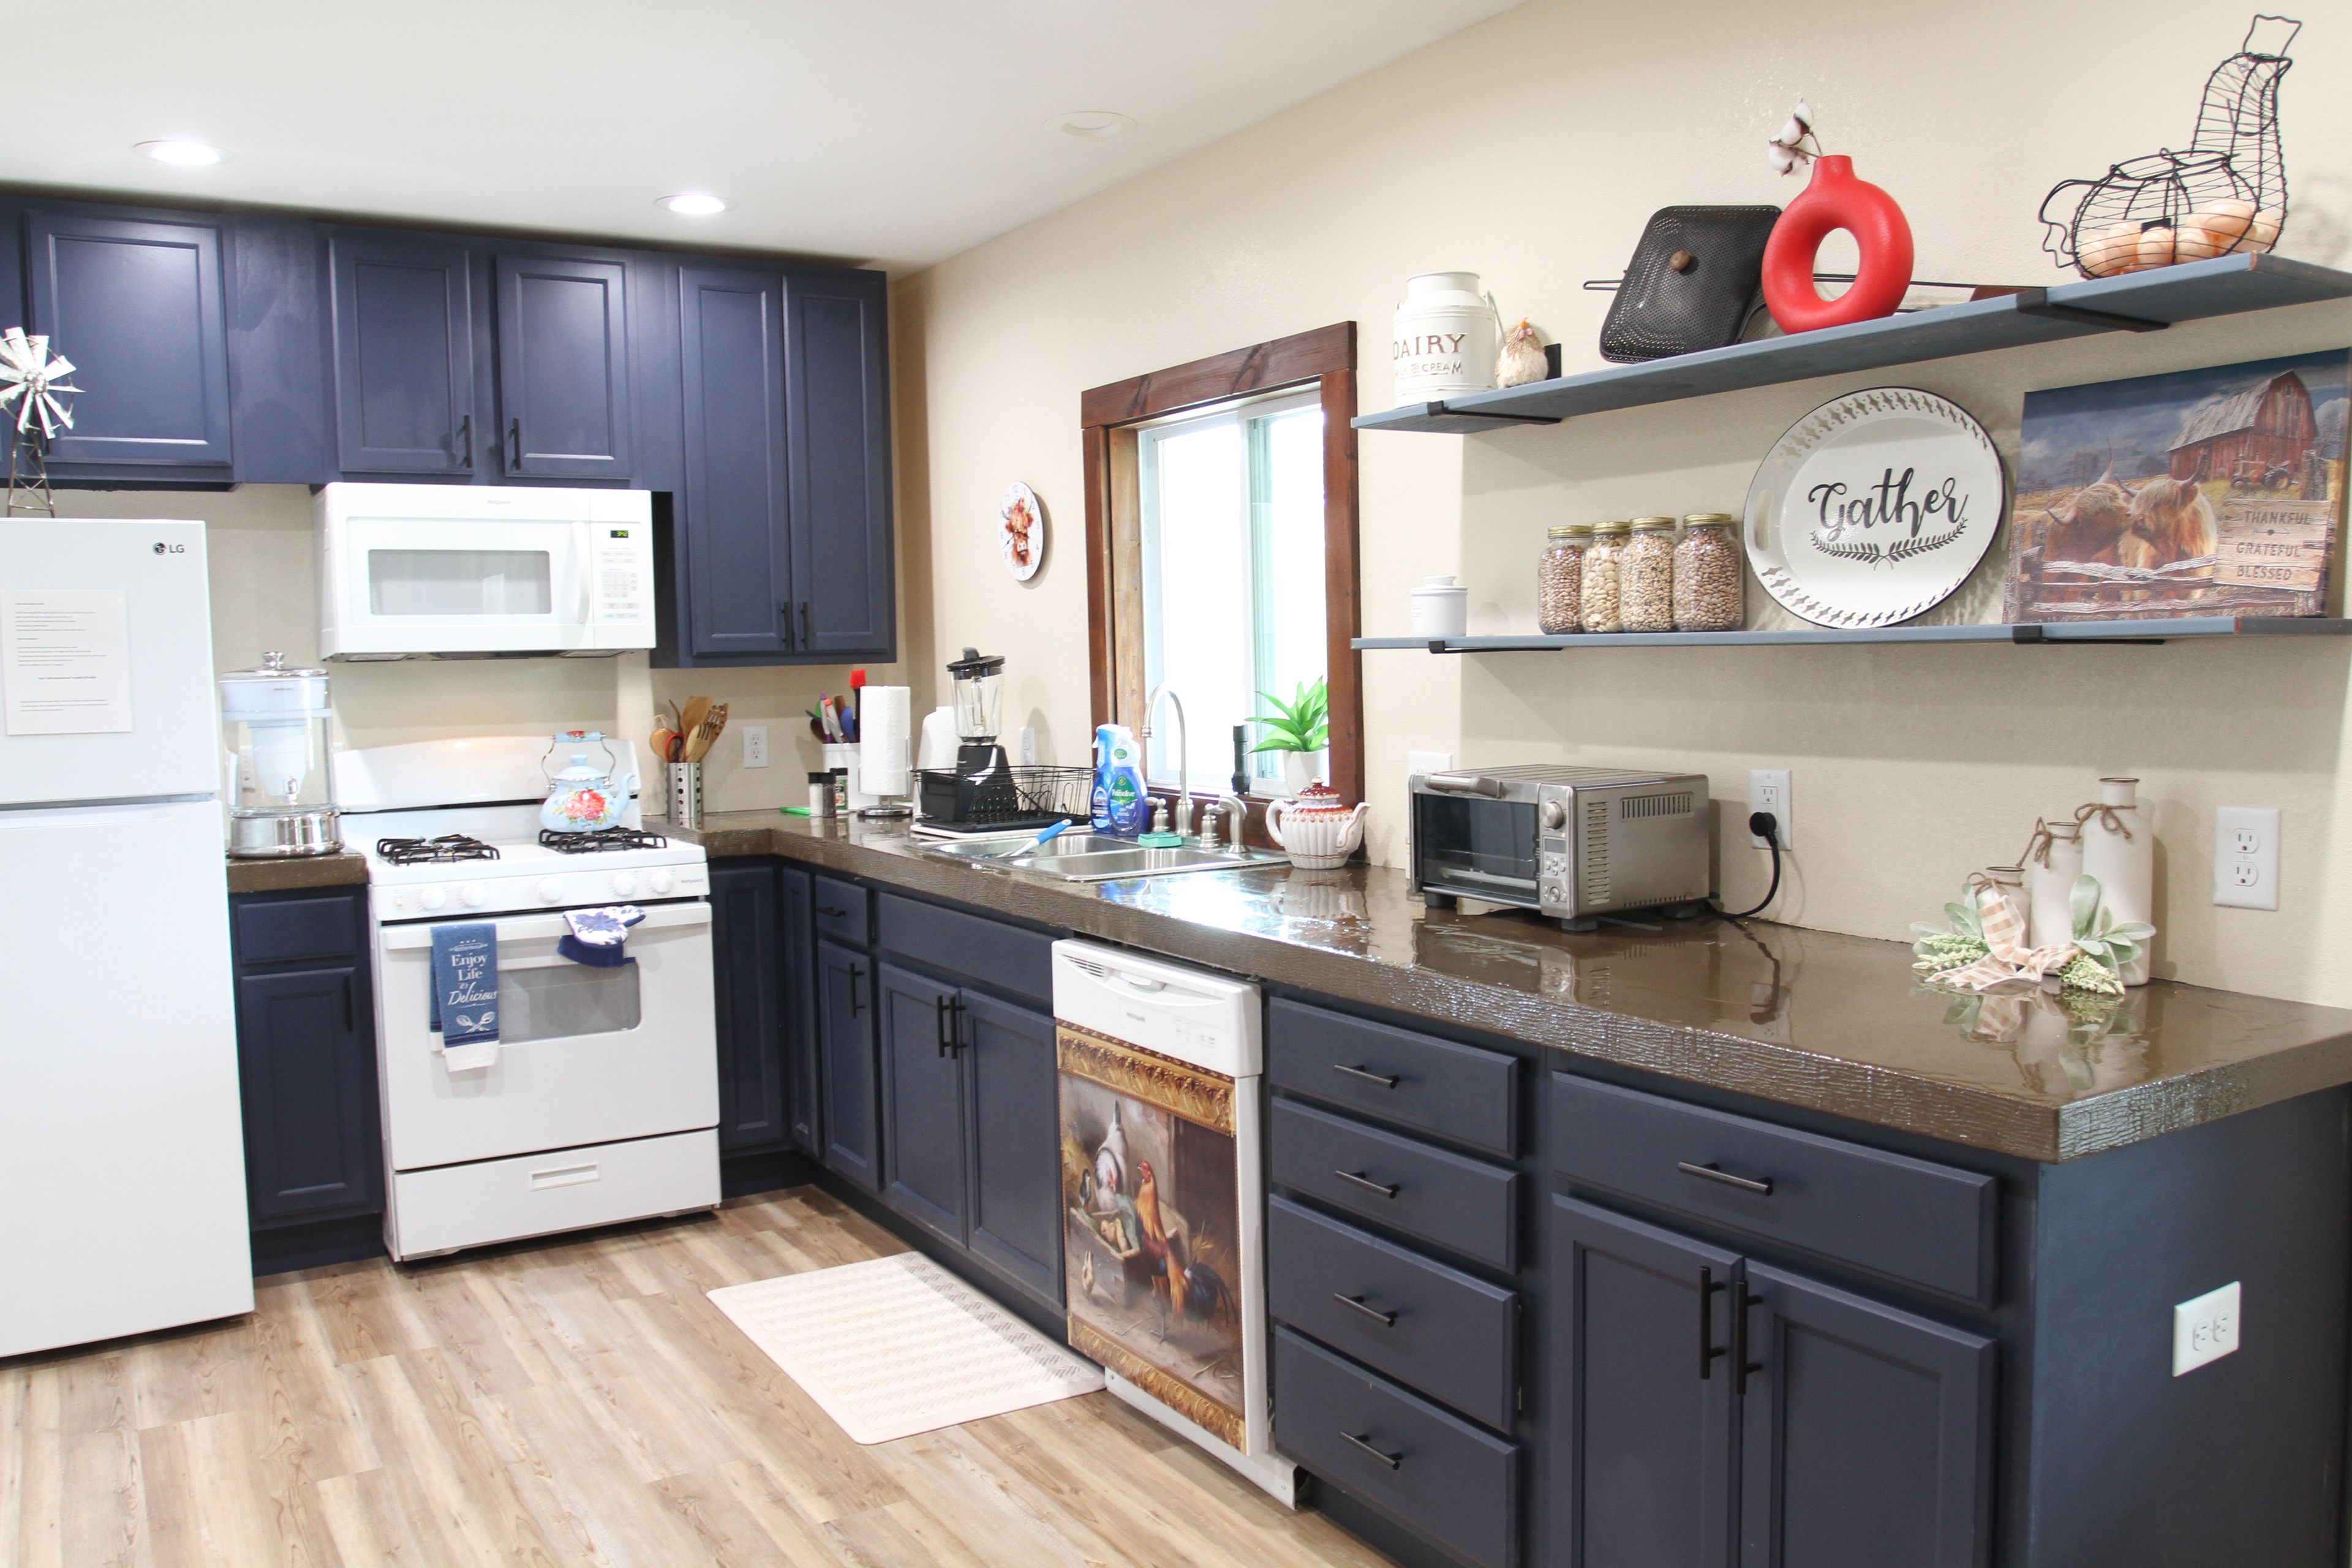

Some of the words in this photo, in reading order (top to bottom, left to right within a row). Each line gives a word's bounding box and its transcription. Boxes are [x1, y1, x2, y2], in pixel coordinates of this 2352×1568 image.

[1393, 333, 1466, 360] DAIRY
[1422, 360, 1463, 374] CREAM
[1808, 467, 1969, 542] Gather
[2245, 510, 2310, 525] THANKFUL
[169, 544, 185, 553] LG
[2236, 542, 2301, 557] GRATEFUL
[2237, 565, 2292, 581] BLESSED
[451, 952, 488, 968] Enjoy
[458, 968, 483, 981] Life
[447, 981, 497, 1006] Delicious
